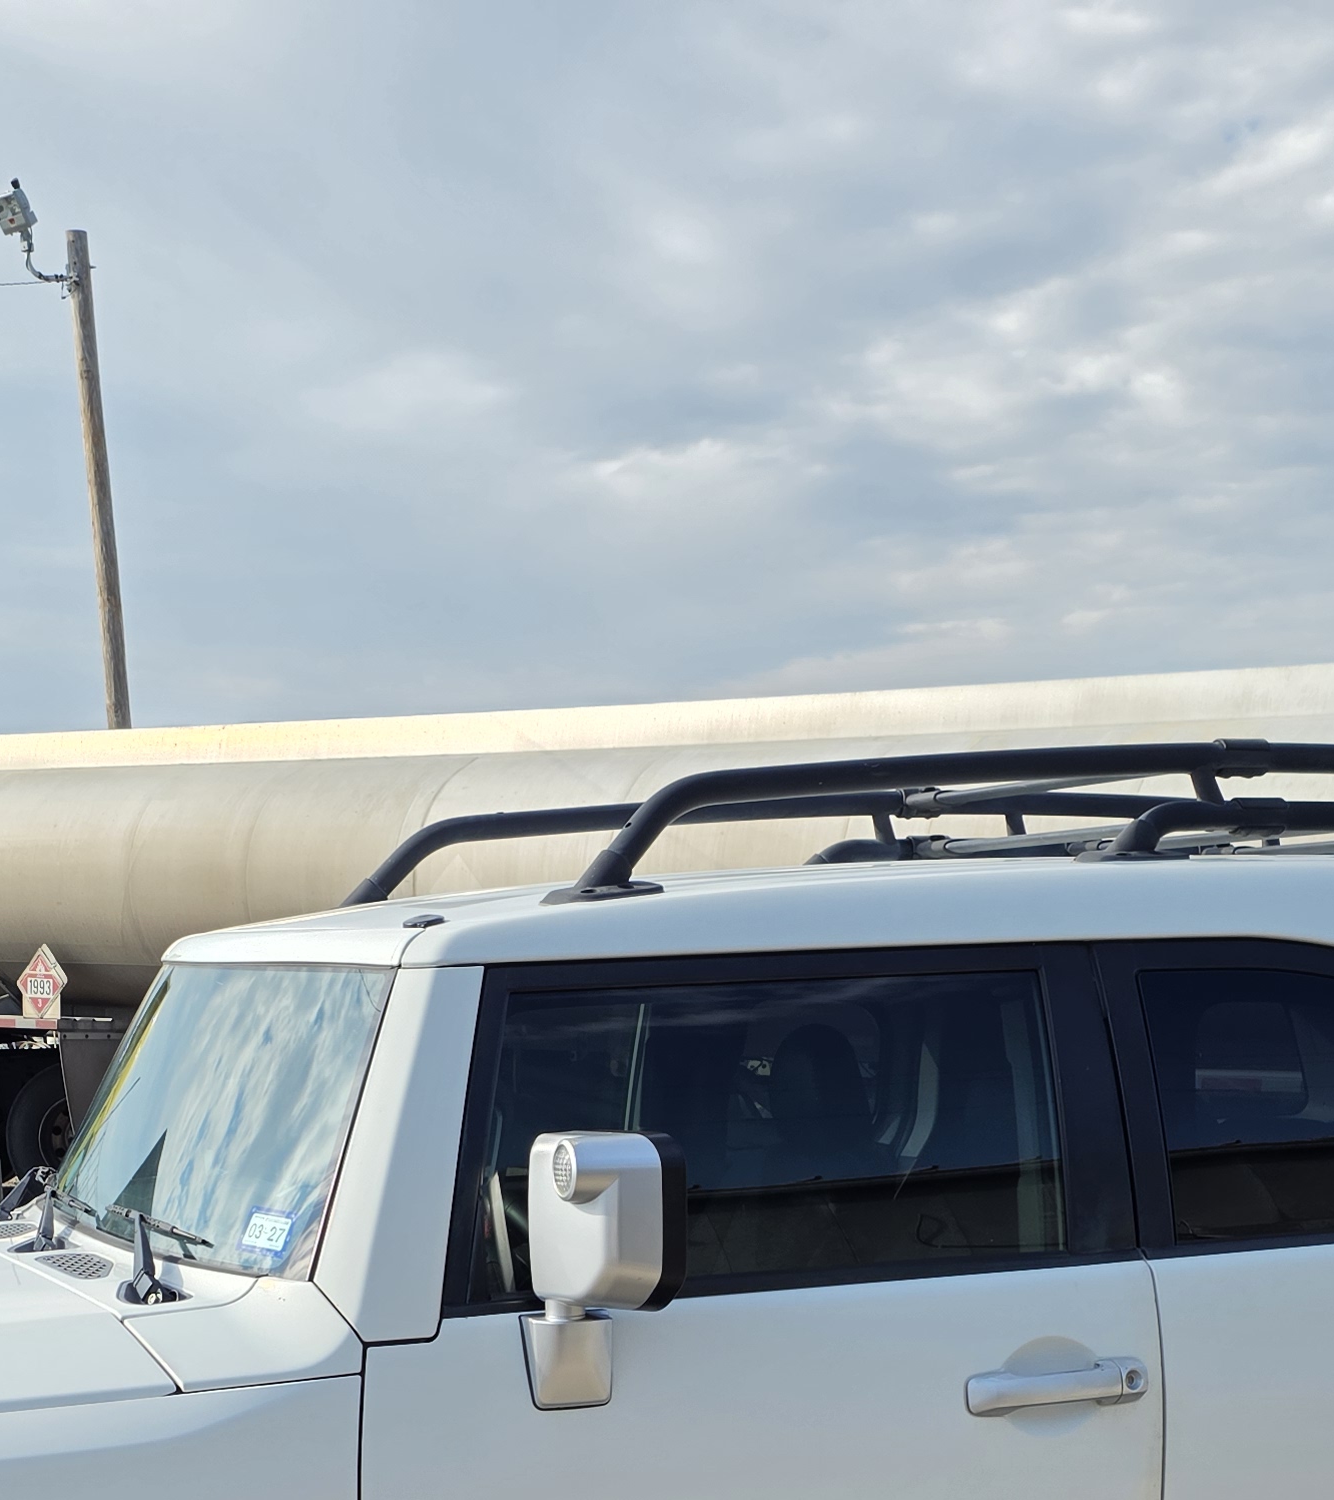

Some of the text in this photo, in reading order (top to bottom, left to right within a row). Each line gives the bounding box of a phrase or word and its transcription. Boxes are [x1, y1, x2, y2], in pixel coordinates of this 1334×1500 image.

[29, 979, 51, 996] 1993
[37, 998, 42, 1007] 3
[248, 1223, 286, 1243] 03 27
